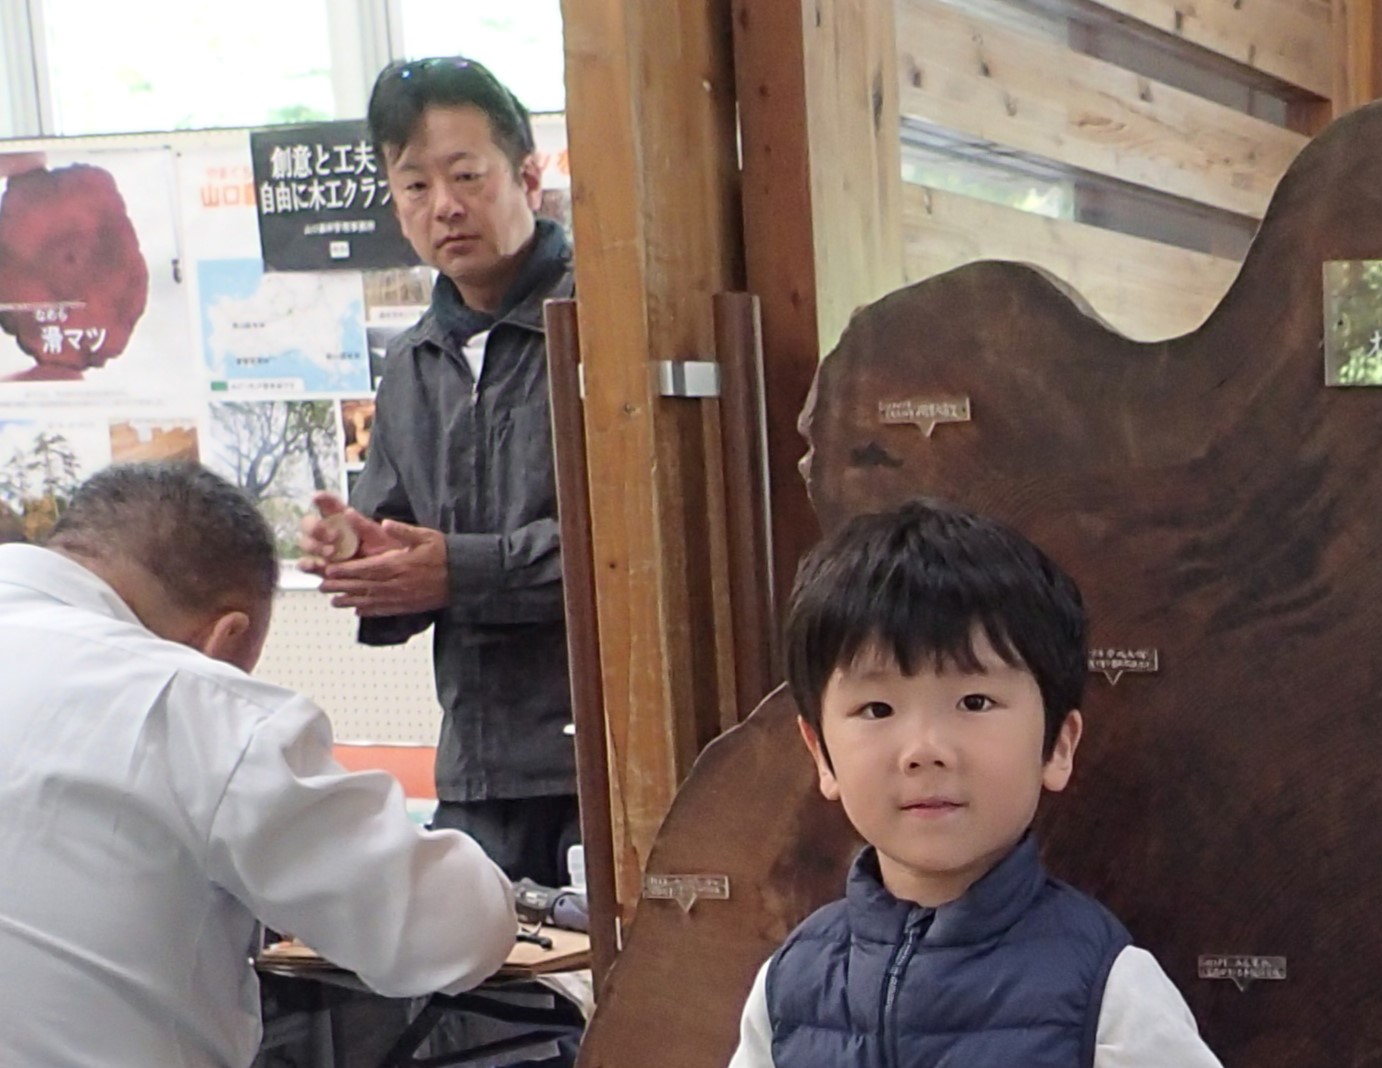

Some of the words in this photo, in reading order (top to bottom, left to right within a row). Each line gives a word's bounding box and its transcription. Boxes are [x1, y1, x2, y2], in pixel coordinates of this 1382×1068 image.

[270, 140, 377, 179] 創意と工夫
[200, 182, 257, 208] 山口
